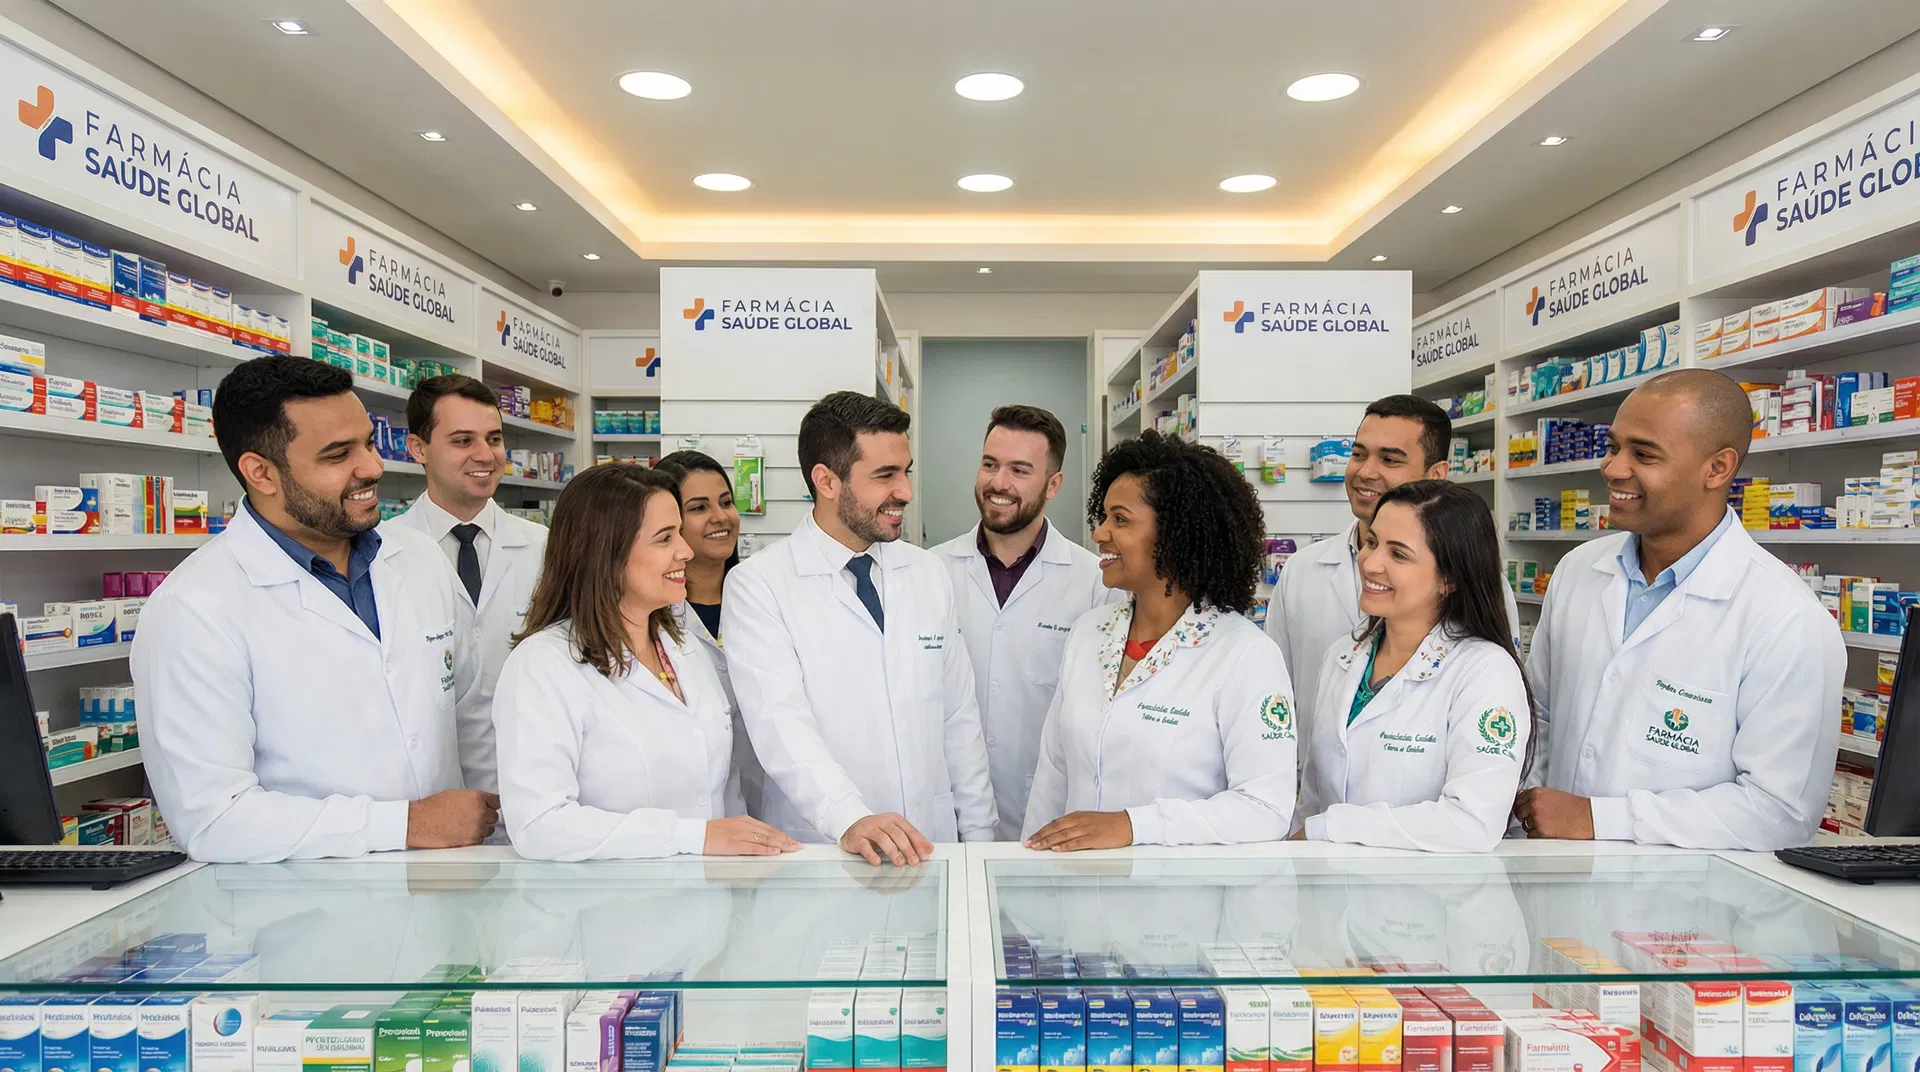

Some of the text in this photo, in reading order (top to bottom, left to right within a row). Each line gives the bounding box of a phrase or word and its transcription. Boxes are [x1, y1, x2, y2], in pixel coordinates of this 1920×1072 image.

[86, 110, 241, 204] FARMÁCIA
[1777, 120, 1915, 201] FARMÁCI
[85, 147, 259, 242] SAÚDE GLOBAL
[1776, 181, 1852, 231] SAÚDE
[369, 249, 446, 298] FARMÁCIA
[1550, 247, 1634, 297] FARMÁCIA
[369, 274, 454, 323] SAÚDE GLOBAL
[722, 296, 835, 312] FARMÁCIA
[1261, 300, 1372, 315] FARMÁCIA
[1549, 266, 1648, 318] SAÚDE GLOBAL
[513, 317, 560, 349] FARMÁCIA
[722, 314, 852, 330] SAÚDE GLOBAL
[1261, 317, 1389, 332] SAÚDE GLOBAL
[1416, 317, 1471, 349] FARMÁCIA
[513, 336, 538, 359] SAÚDE
[1416, 333, 1479, 367] SAÚDE GLOBAL
[1648, 726, 1700, 748] FARMÁCIA
